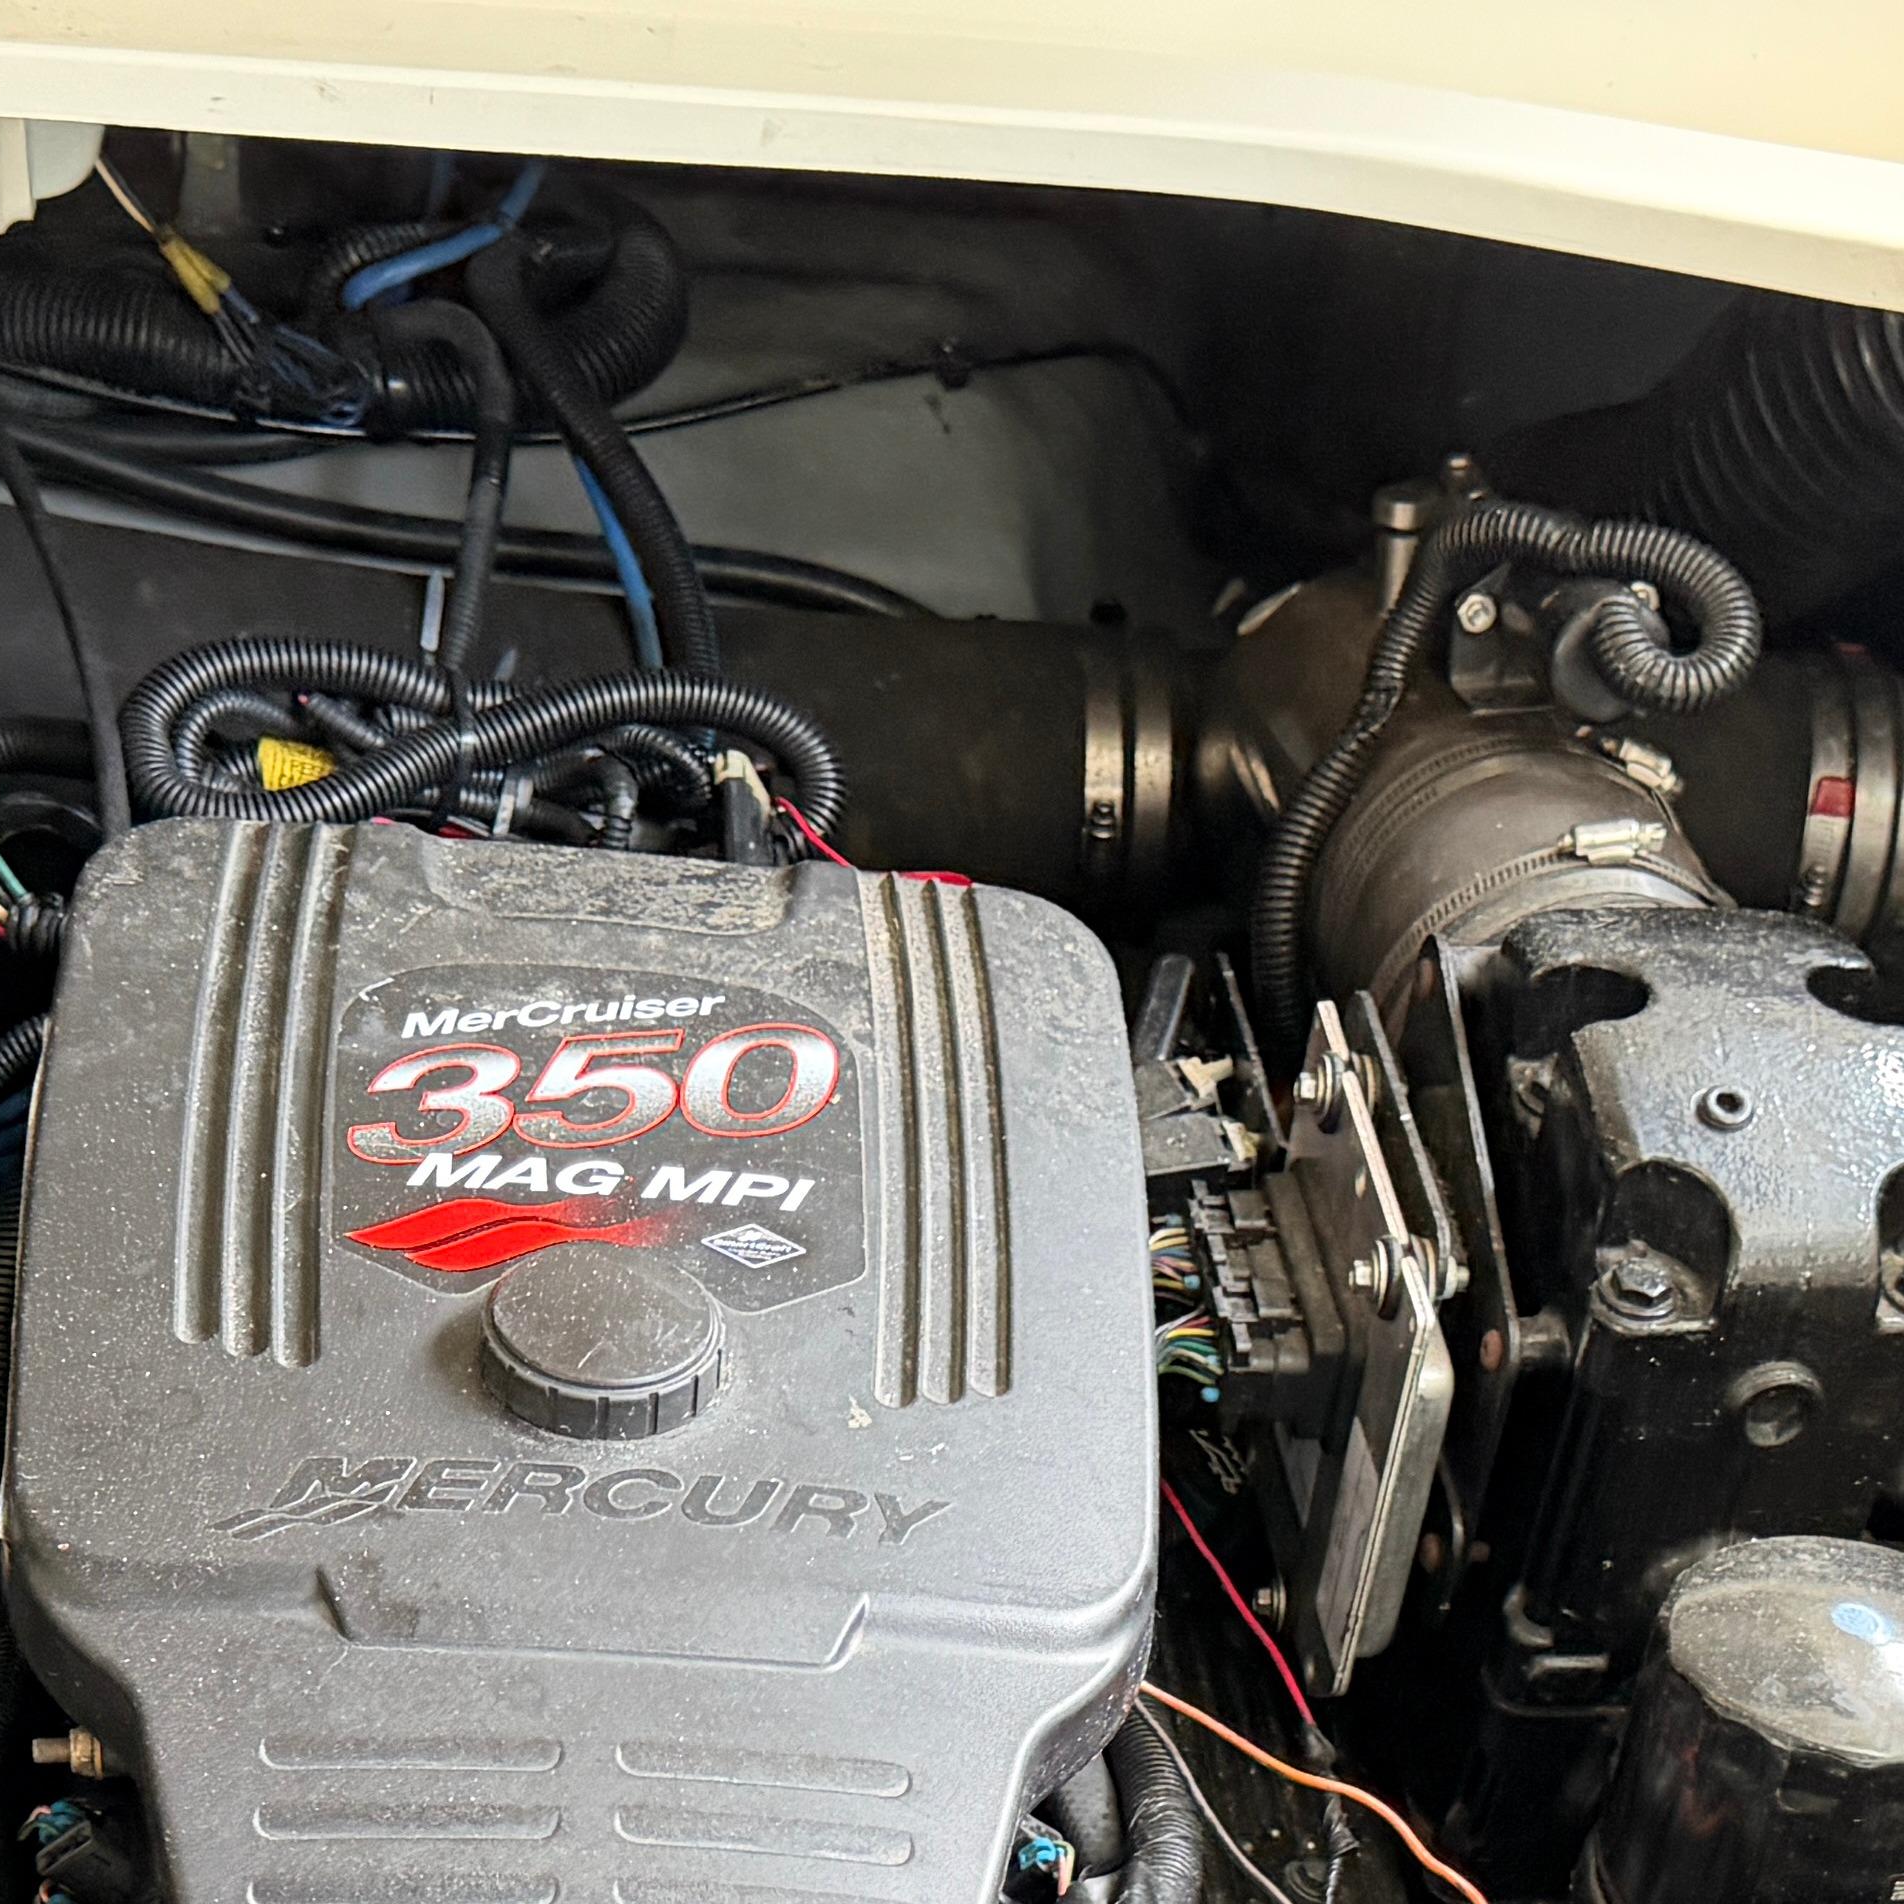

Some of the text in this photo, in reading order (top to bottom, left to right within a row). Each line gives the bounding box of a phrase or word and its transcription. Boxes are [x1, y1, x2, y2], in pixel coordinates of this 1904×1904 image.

[400, 989, 726, 1040] MerCruiser
[346, 1022, 842, 1166] 350
[406, 1152, 818, 1213] MAG MPI
[214, 1455, 952, 1546] MERCURY
